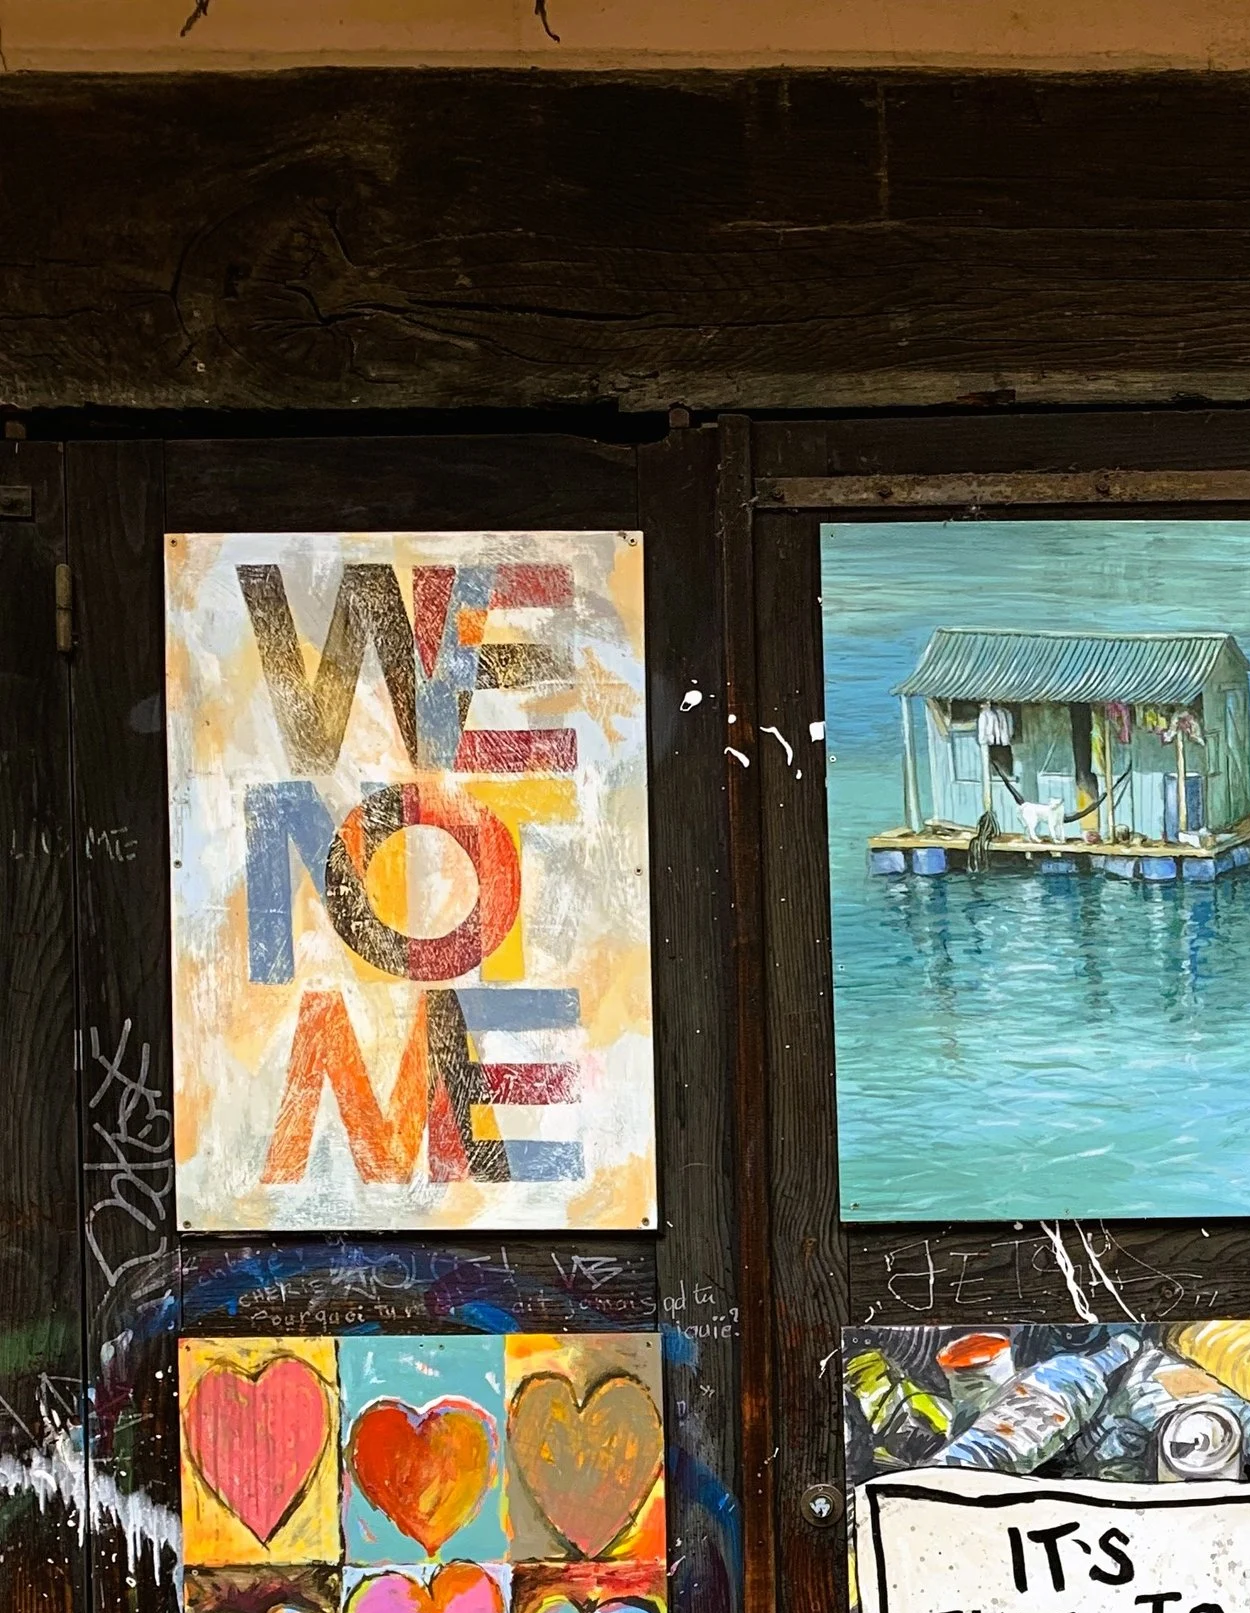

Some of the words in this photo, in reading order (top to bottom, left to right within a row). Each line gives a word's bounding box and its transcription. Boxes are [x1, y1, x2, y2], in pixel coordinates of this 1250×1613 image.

[235, 563, 578, 774] WE
[245, 780, 578, 982] NOT
[260, 988, 585, 1184] ME
[1007, 1521, 1135, 1594] IT'S
